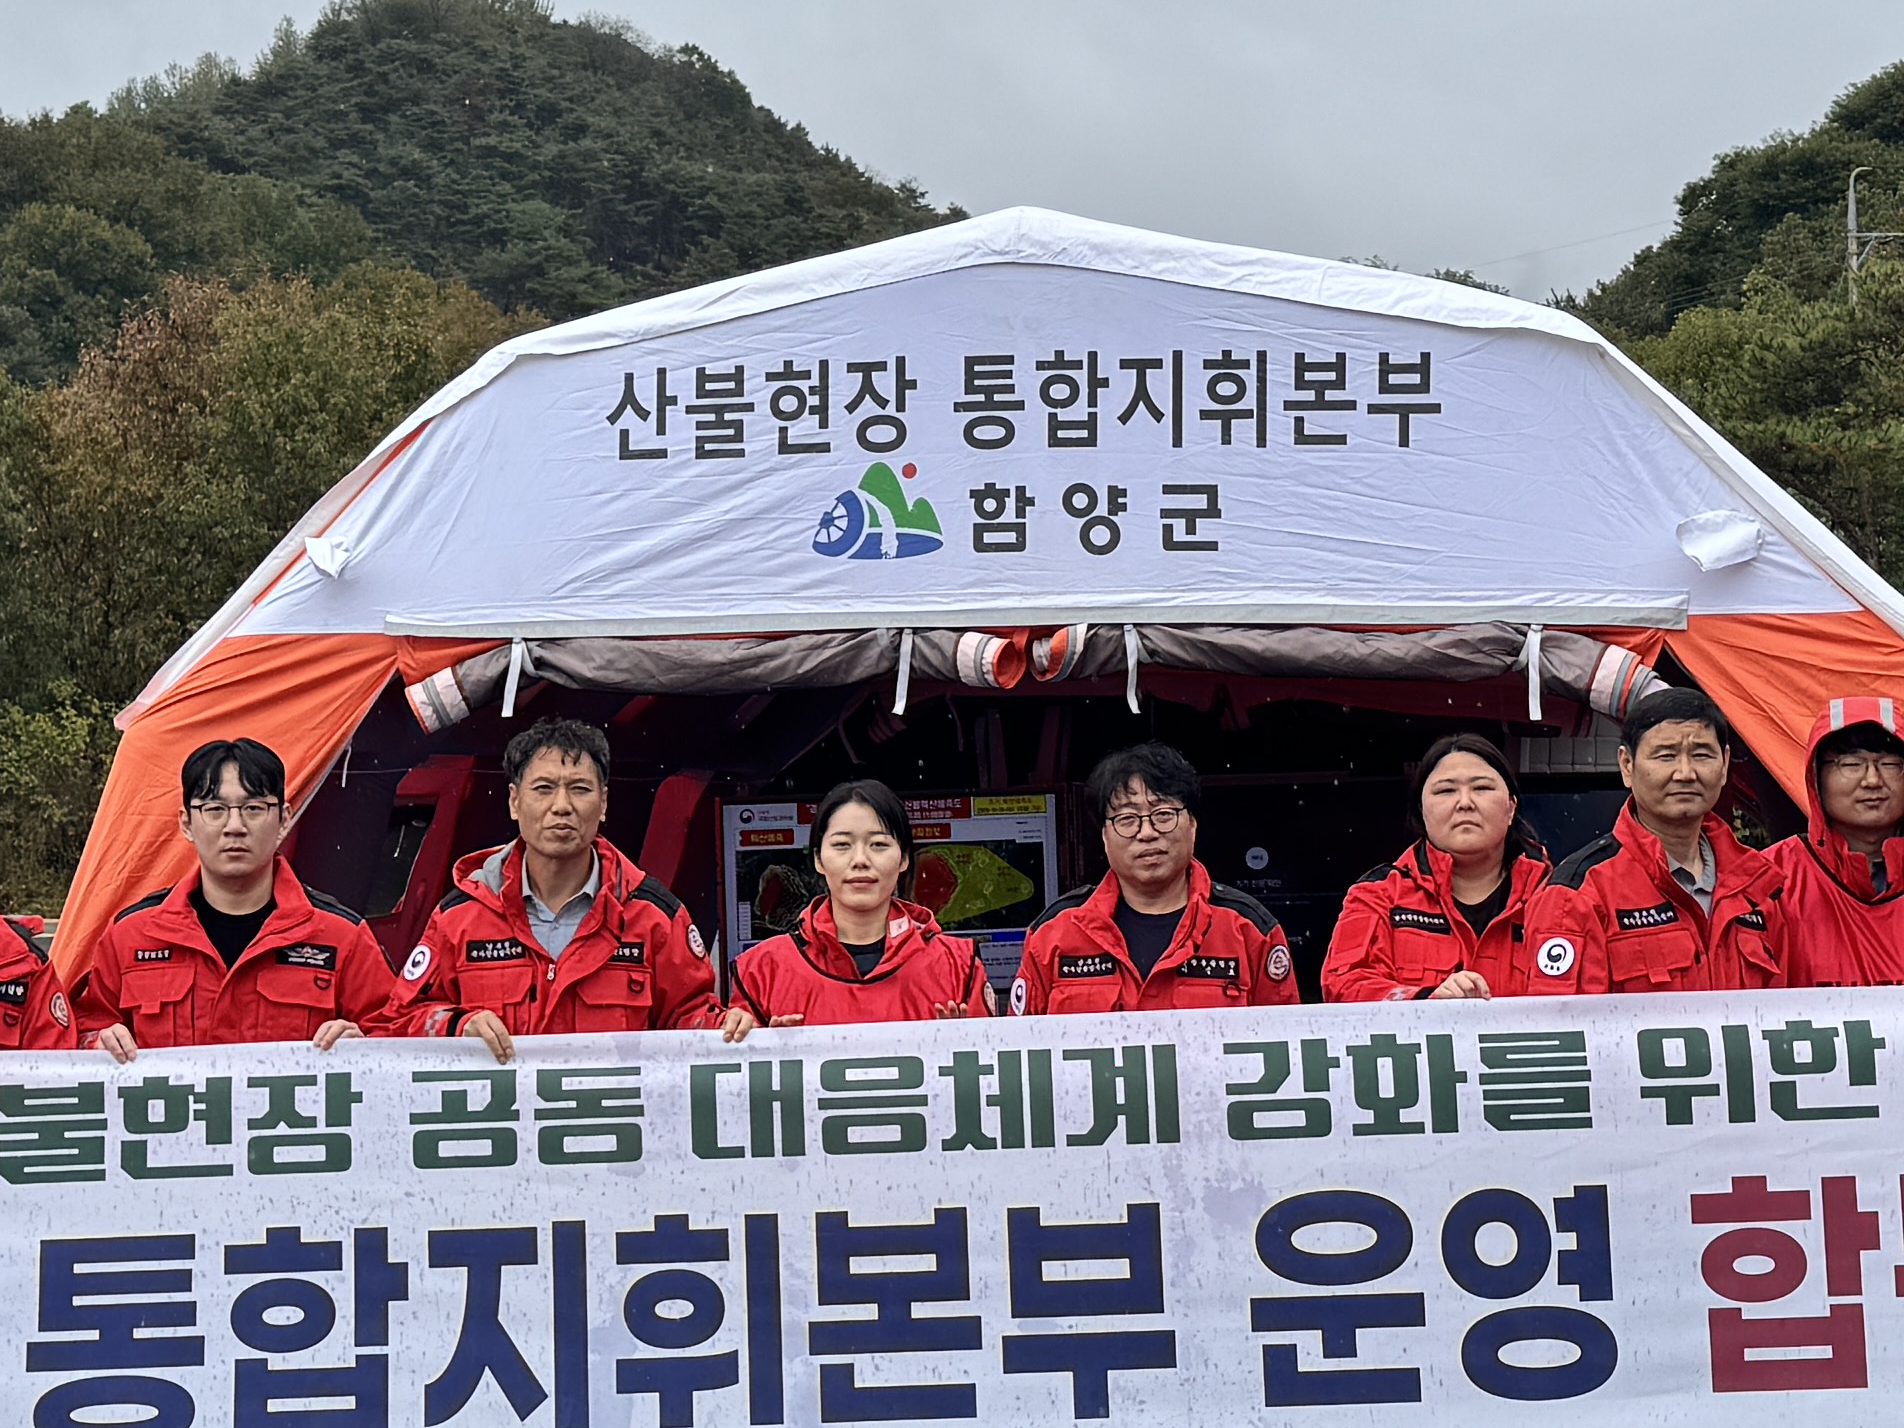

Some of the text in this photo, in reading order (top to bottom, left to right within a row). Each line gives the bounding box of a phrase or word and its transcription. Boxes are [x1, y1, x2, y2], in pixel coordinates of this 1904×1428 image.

[607, 350, 1442, 460] 산불현장 통합지휘본부
[969, 483, 1222, 555] 함양군
[409, 1067, 644, 1169] 공동
[690, 1044, 1180, 1159] 대응체계
[1223, 1031, 1593, 1141] 강화를
[1637, 1020, 1886, 1125] 위한
[1250, 1185, 1618, 1402] 운영
